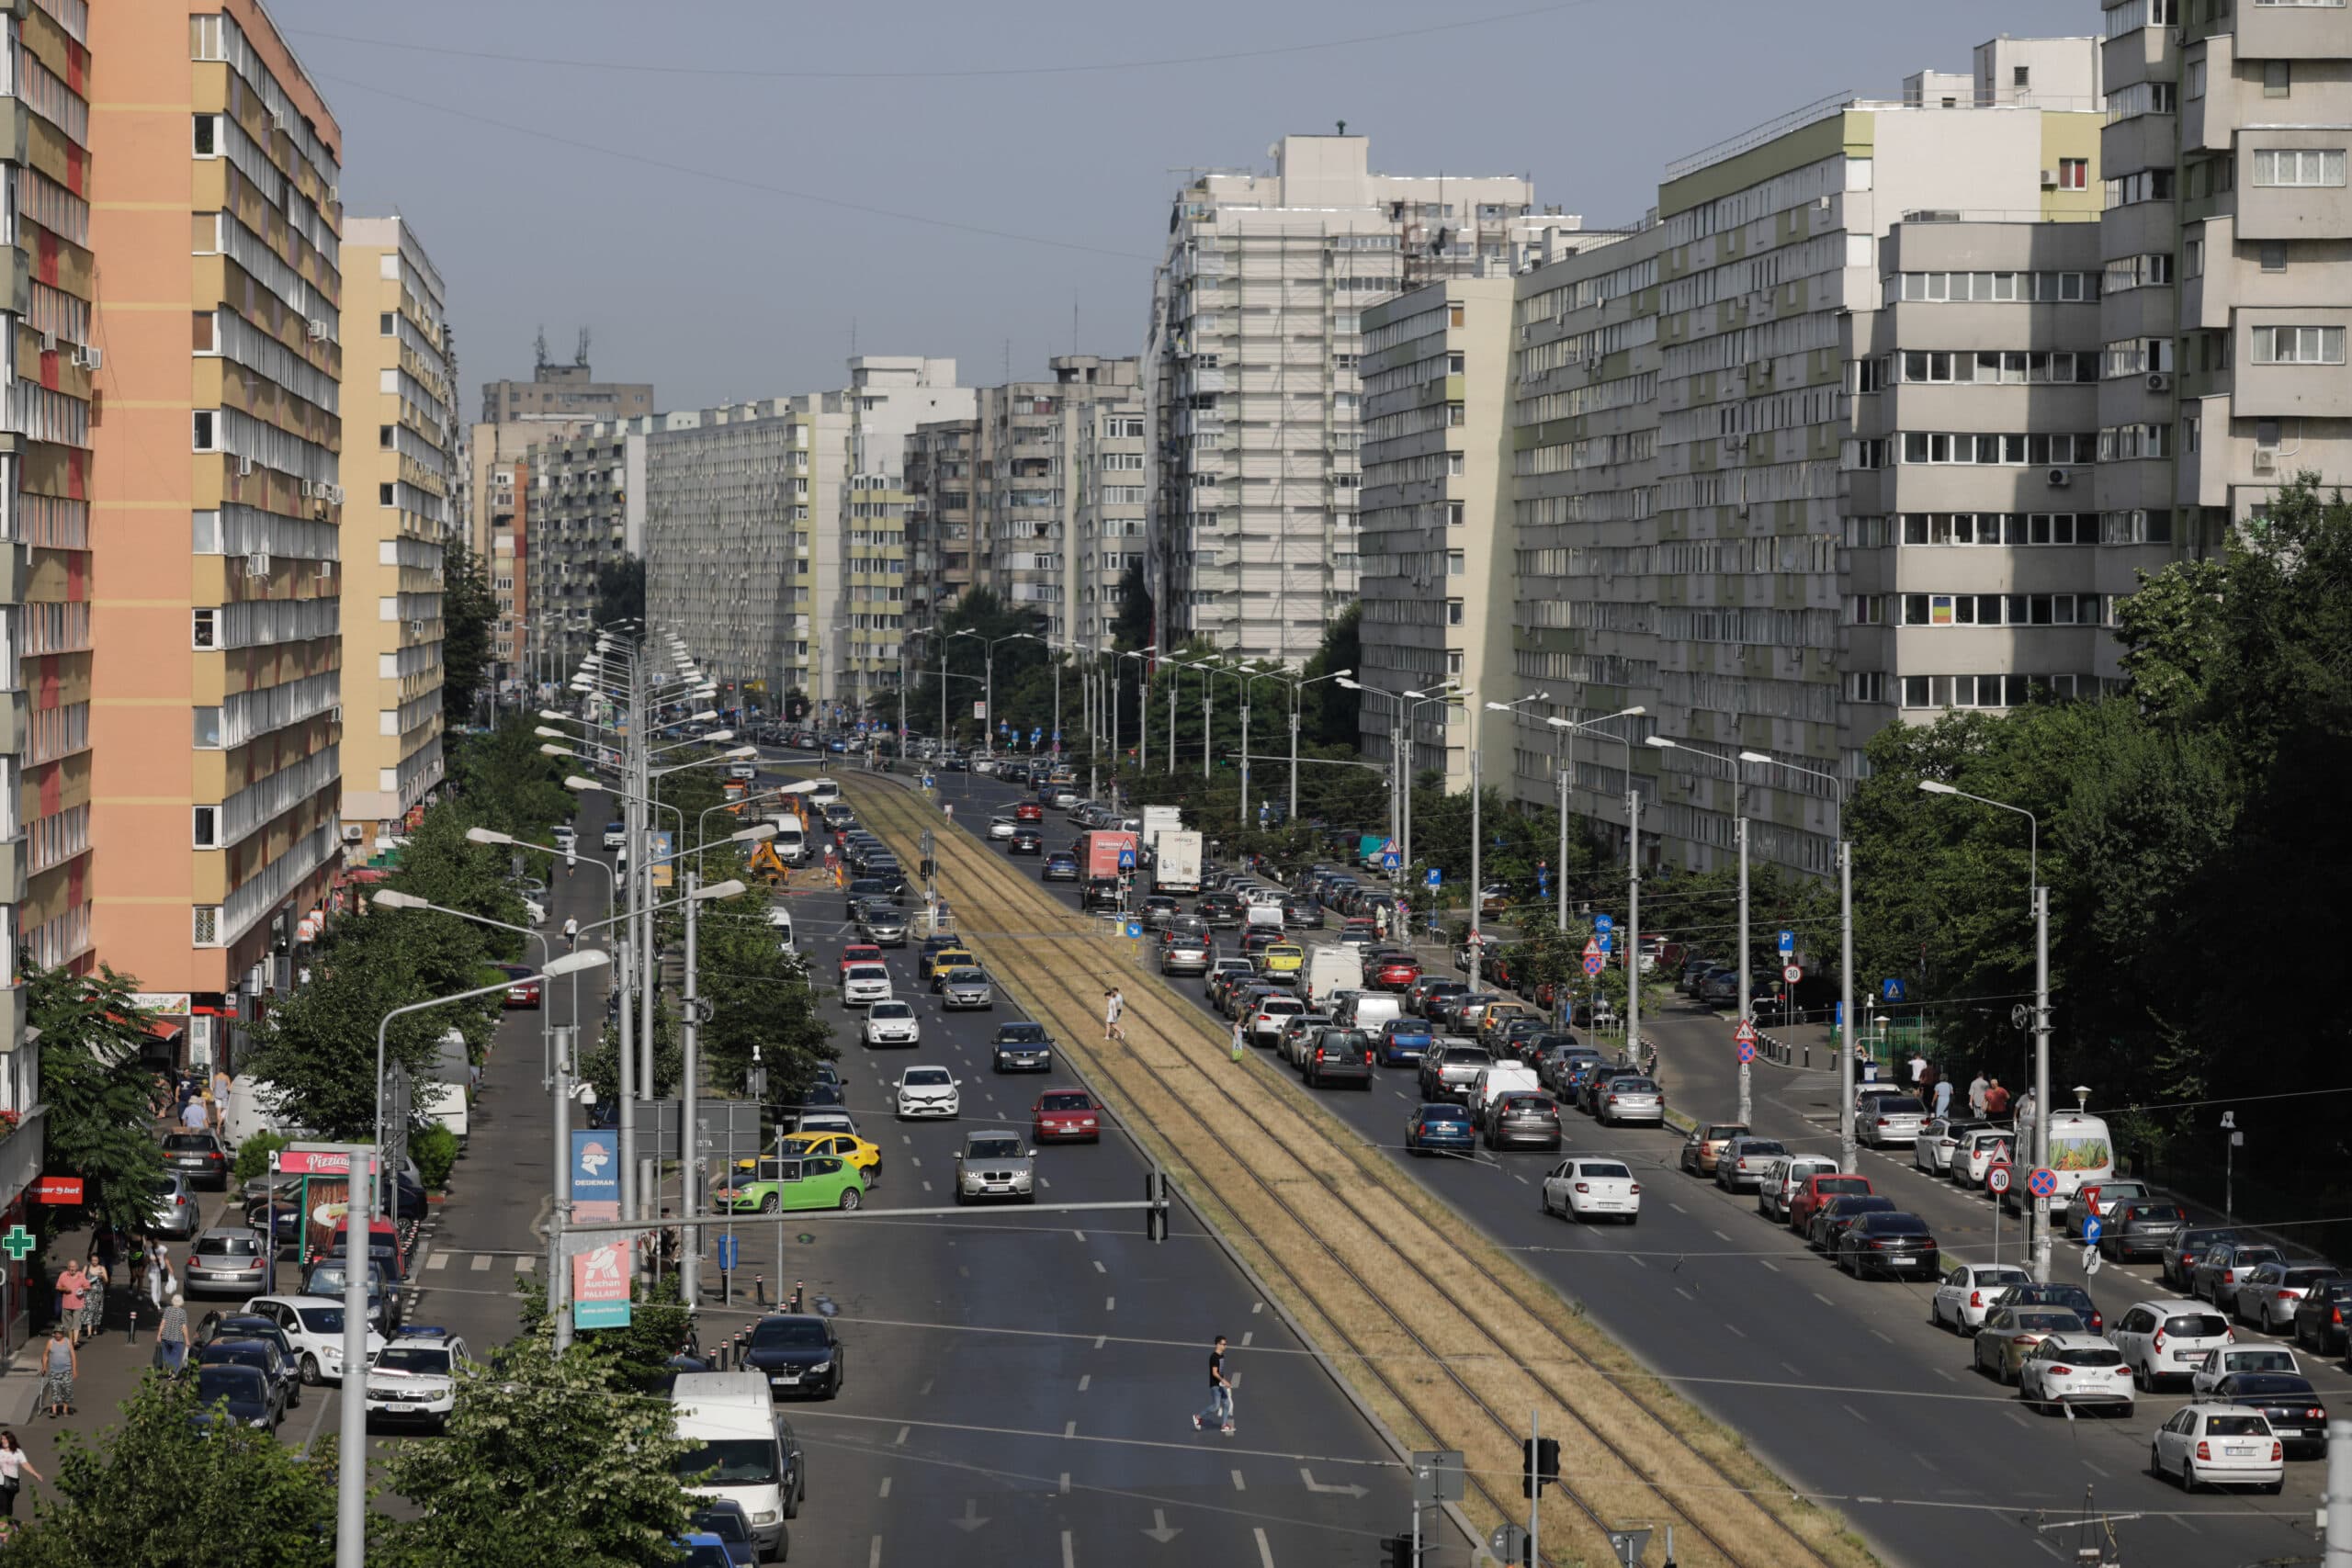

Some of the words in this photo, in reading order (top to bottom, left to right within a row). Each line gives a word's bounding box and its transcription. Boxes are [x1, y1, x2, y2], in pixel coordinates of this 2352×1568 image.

[1430, 870, 1438, 880] P
[1600, 933, 1608, 946] P
[1781, 932, 1791, 945] P
[1787, 969, 1798, 979] 30
[306, 1154, 350, 1171] Pizzica
[1994, 1174, 2007, 1187] 30
[2086, 1252, 2097, 1266] 30
[583, 1280, 621, 1288] Auchan
[583, 1290, 621, 1298] PALLADY
